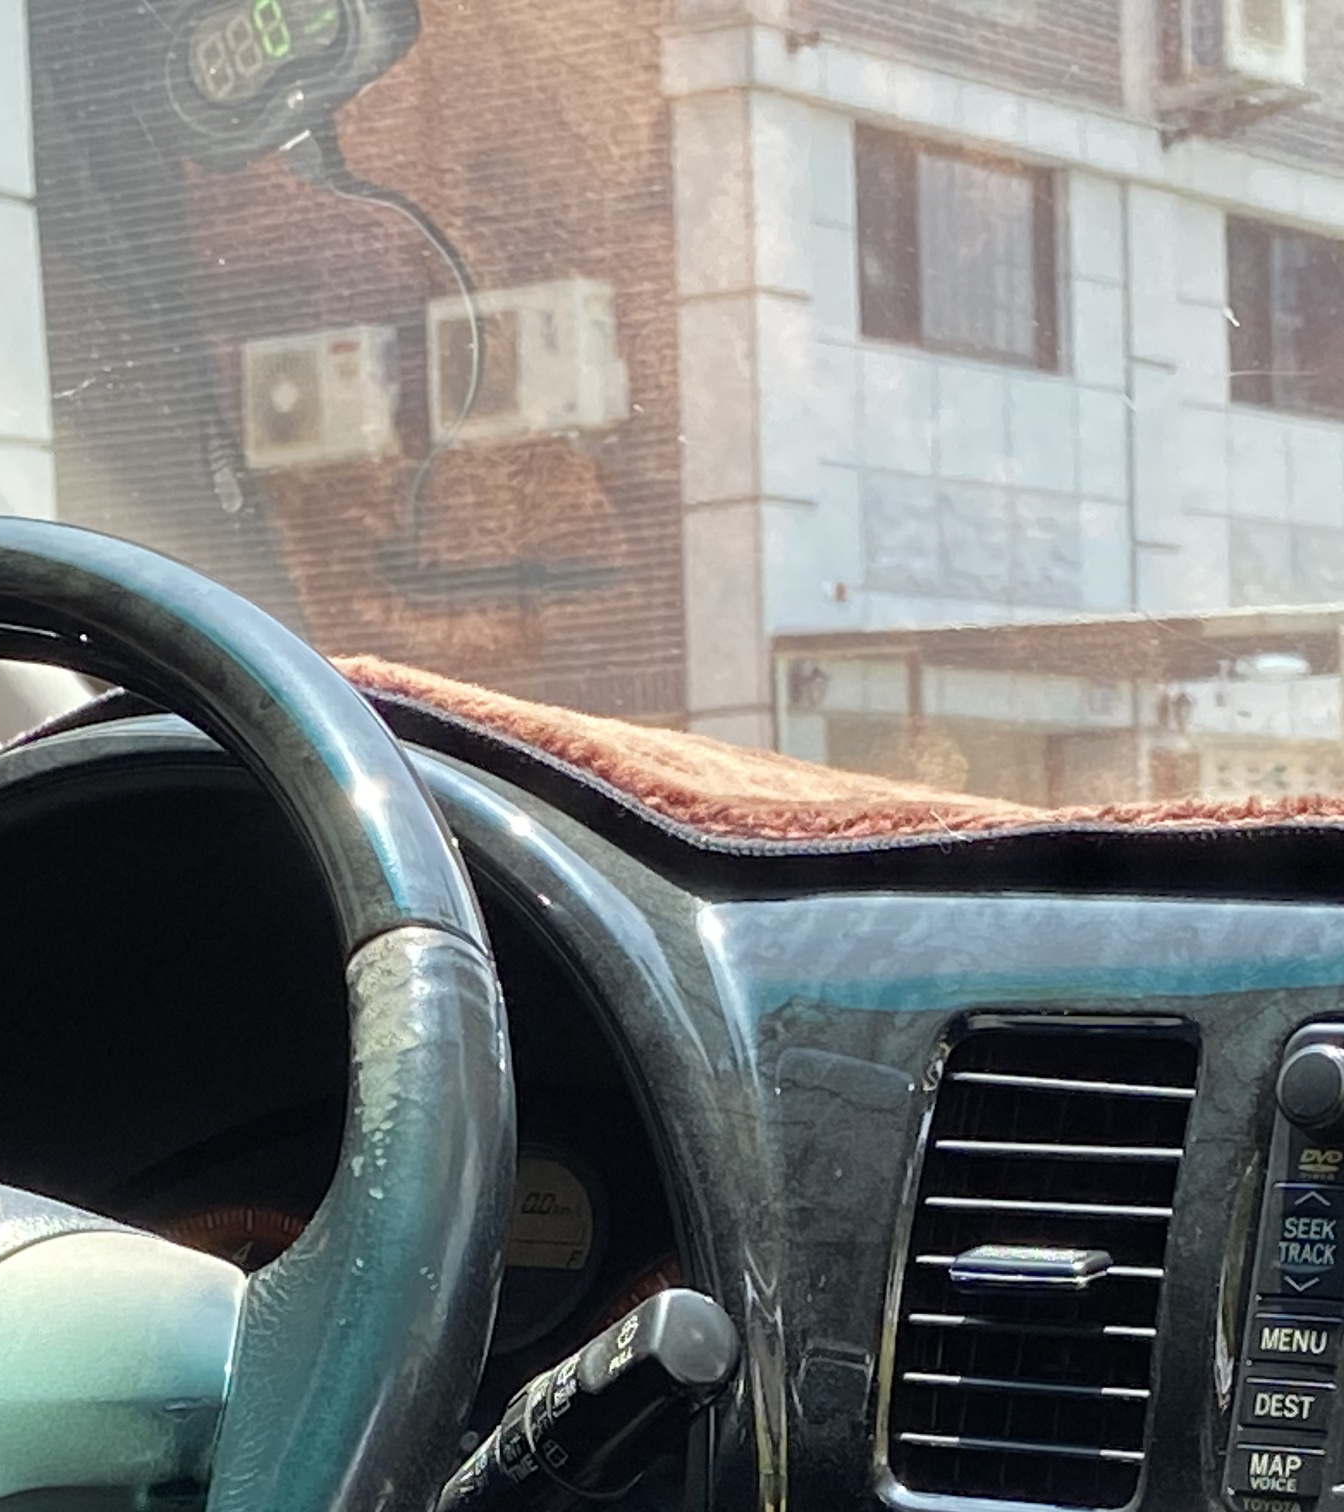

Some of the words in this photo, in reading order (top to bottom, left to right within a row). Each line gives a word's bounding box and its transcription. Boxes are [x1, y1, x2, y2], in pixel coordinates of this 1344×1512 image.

[1283, 1217, 1336, 1240] SEEK
[1278, 1241, 1336, 1267] TRACK
[1260, 1328, 1327, 1355] MENU
[1254, 1393, 1315, 1420] DEST
[1249, 1452, 1303, 1479] MAP
[1249, 1475, 1298, 1493] VOICE
